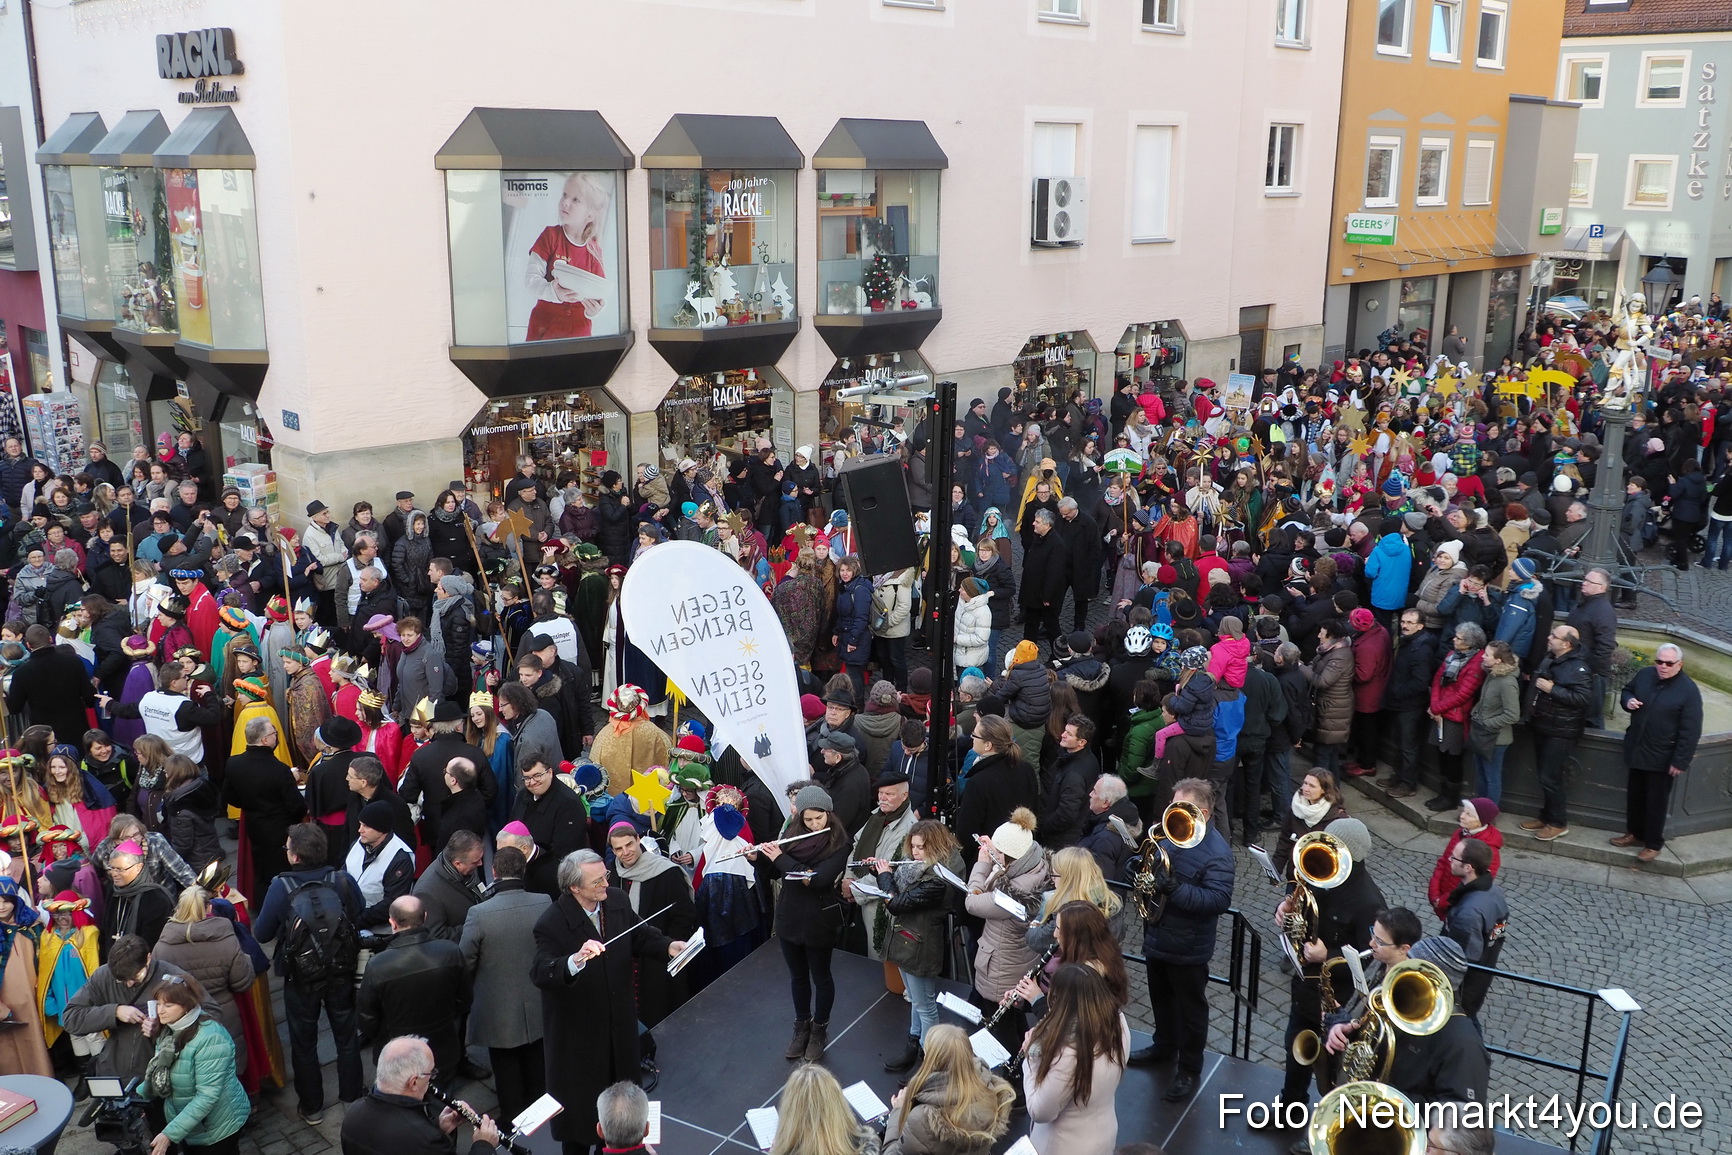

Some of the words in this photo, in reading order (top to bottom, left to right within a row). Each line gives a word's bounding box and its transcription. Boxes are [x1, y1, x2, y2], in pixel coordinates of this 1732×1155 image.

[156, 27, 236, 79] RACKL
[178, 91, 194, 104] am
[194, 79, 238, 104] Rathaus
[1687, 62, 1715, 198] satzke
[504, 178, 548, 191] Thomas
[728, 179, 743, 191] 100
[743, 176, 769, 191] Jahre
[724, 192, 762, 216] RACKL
[1351, 219, 1383, 230] GEERS
[1592, 226, 1602, 237] P
[1045, 345, 1066, 363] RACKL
[713, 385, 745, 407] RACKL
[471, 423, 518, 436] Willkommen
[520, 421, 530, 430] im
[532, 410, 571, 435] RACKL
[573, 411, 621, 422] Erlebnishaus.
